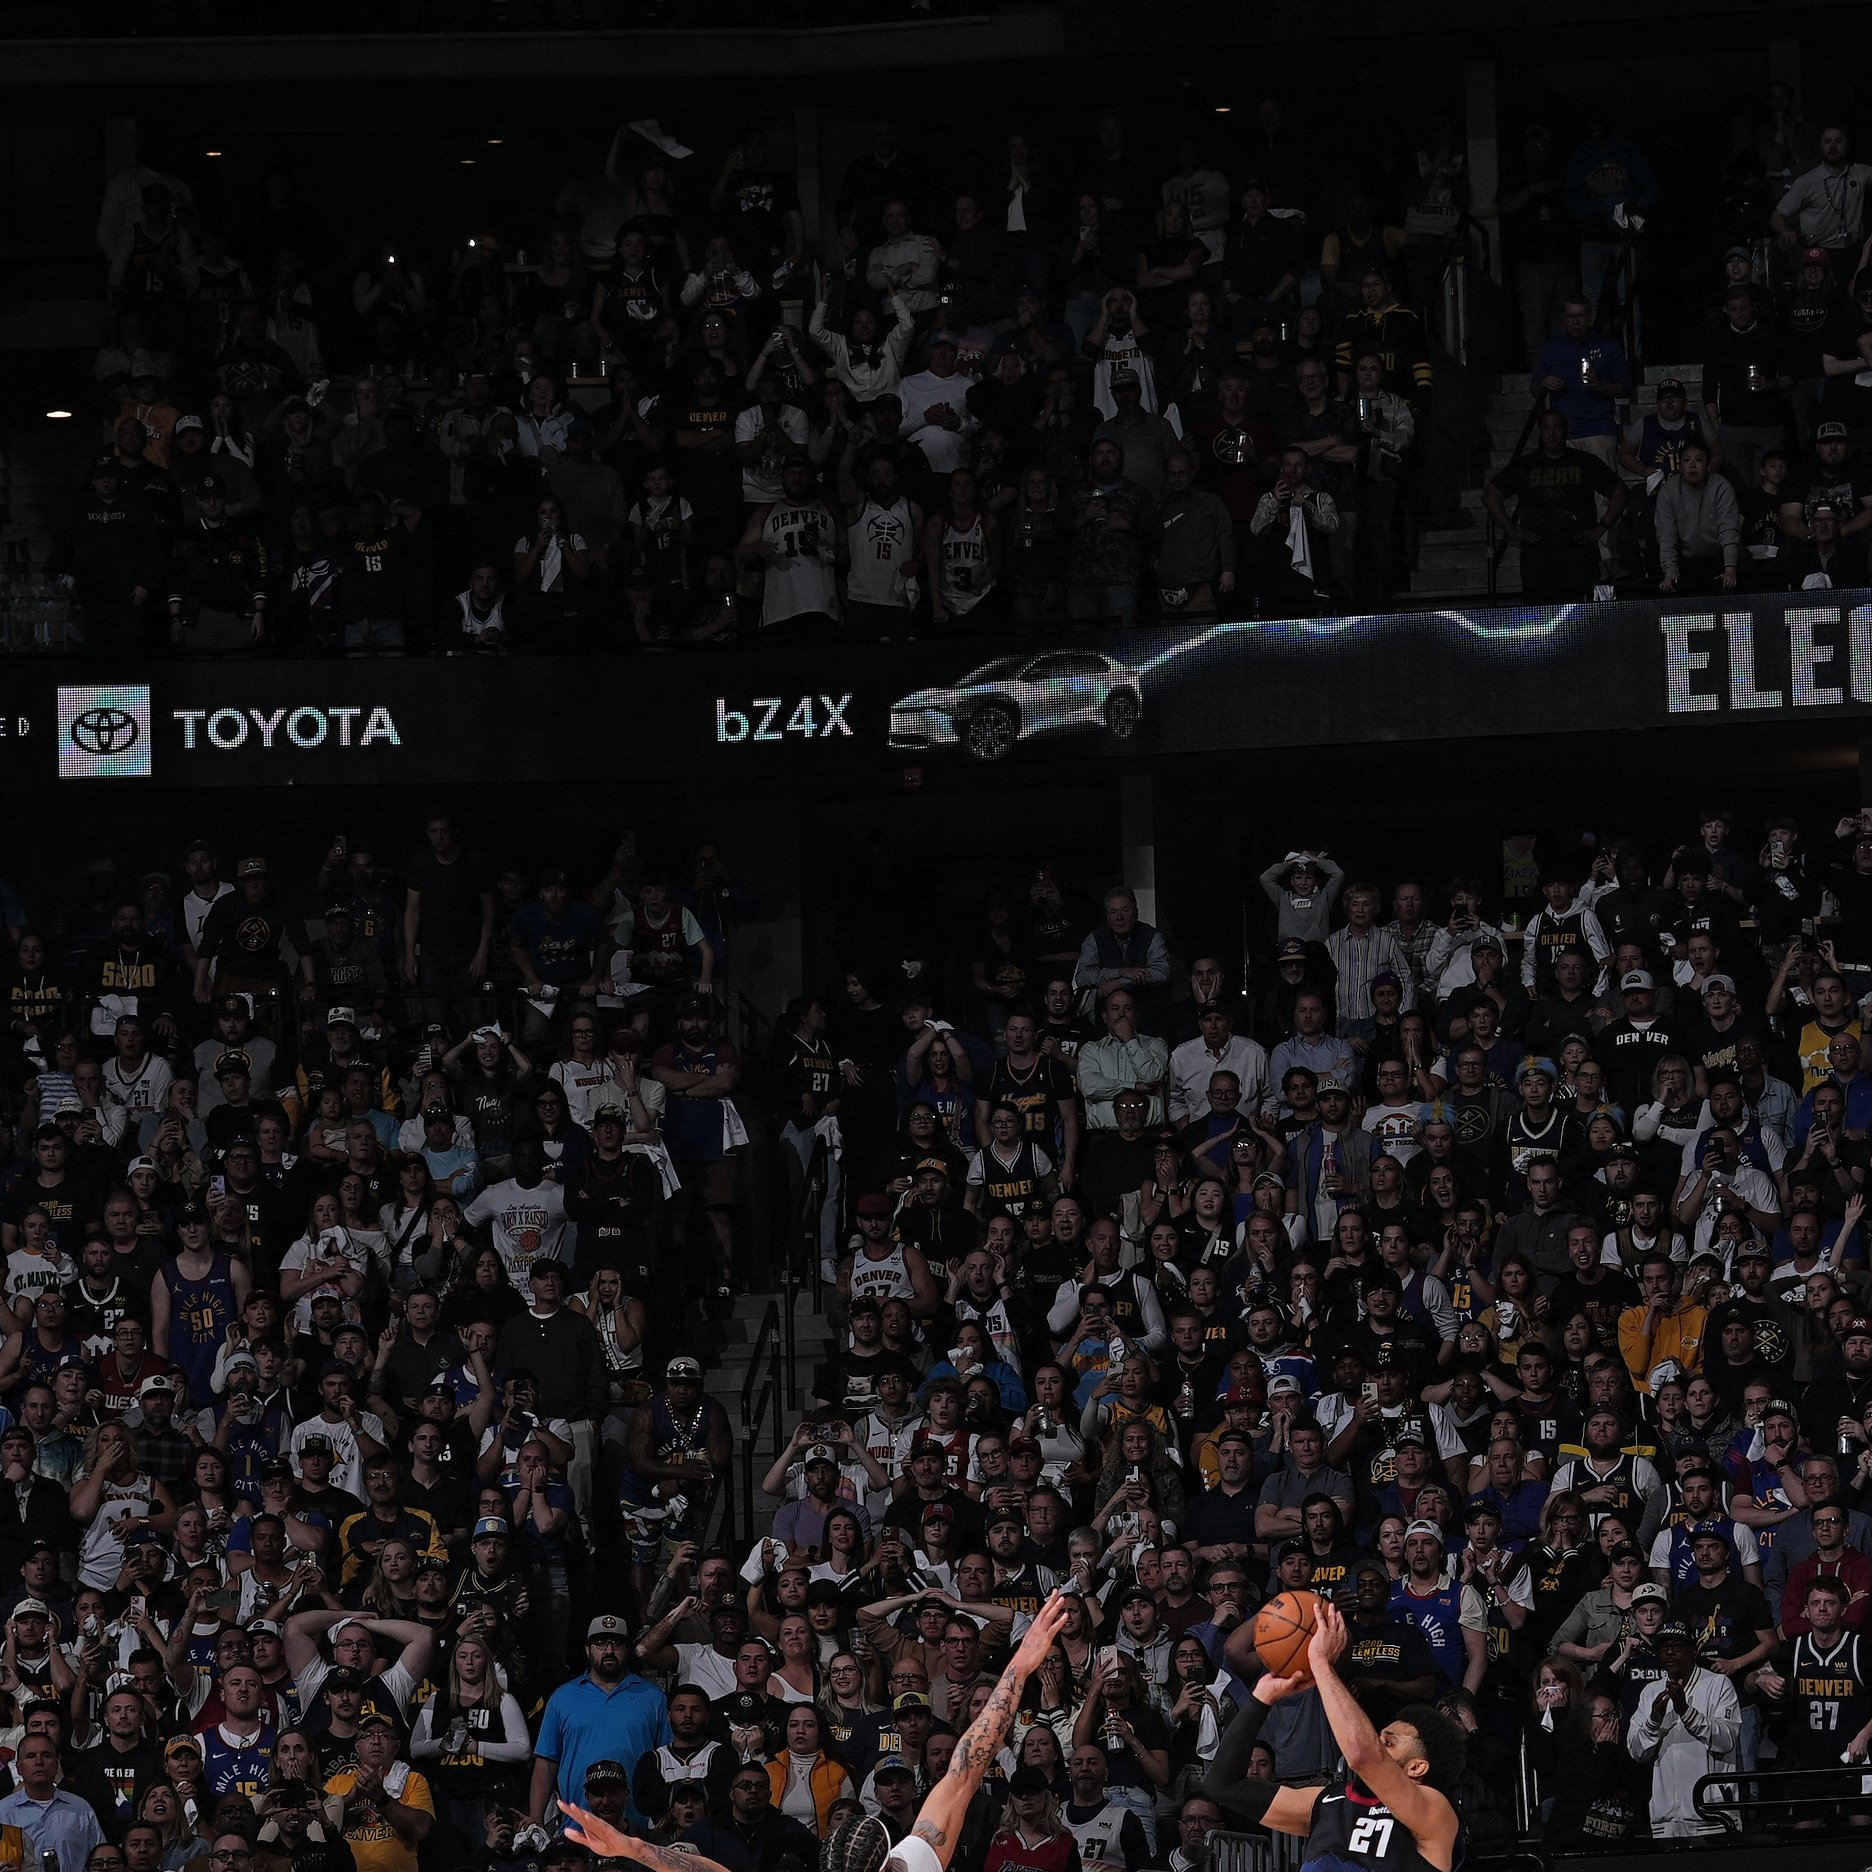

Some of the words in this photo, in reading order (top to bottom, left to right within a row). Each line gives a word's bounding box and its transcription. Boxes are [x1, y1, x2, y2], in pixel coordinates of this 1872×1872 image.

[689, 412, 727, 425] DENVER
[772, 514, 828, 532] DENVER
[876, 541, 893, 561] 15
[364, 555, 383, 572] 15
[172, 706, 403, 749] TOYOTA
[716, 695, 853, 742] bZ4X
[662, 933, 678, 948] 27
[1541, 933, 1577, 946] DENVER
[1060, 1040, 1078, 1055] 27
[812, 1073, 832, 1092] 27
[1321, 1080, 1340, 1091] USA
[134, 1090, 151, 1107] 27
[1026, 1113, 1046, 1131] 15
[1215, 1240, 1231, 1257] 15
[854, 1269, 901, 1284] DENVER
[1453, 1283, 1473, 1309] 15
[180, 1296, 203, 1323] MILE
[203, 1296, 227, 1320] HIGH
[192, 1309, 215, 1331] 50
[192, 1331, 216, 1343] CITY
[1539, 1420, 1557, 1440] 15
[234, 1477, 263, 1491] CITY
[1798, 1678, 1853, 1697] DENVER
[467, 1710, 491, 1730] 50
[1809, 1700, 1839, 1731] 27
[217, 1770, 240, 1796] MILE
[1351, 1818, 1393, 1857] 27
[1084, 1837, 1105, 1860] 27
